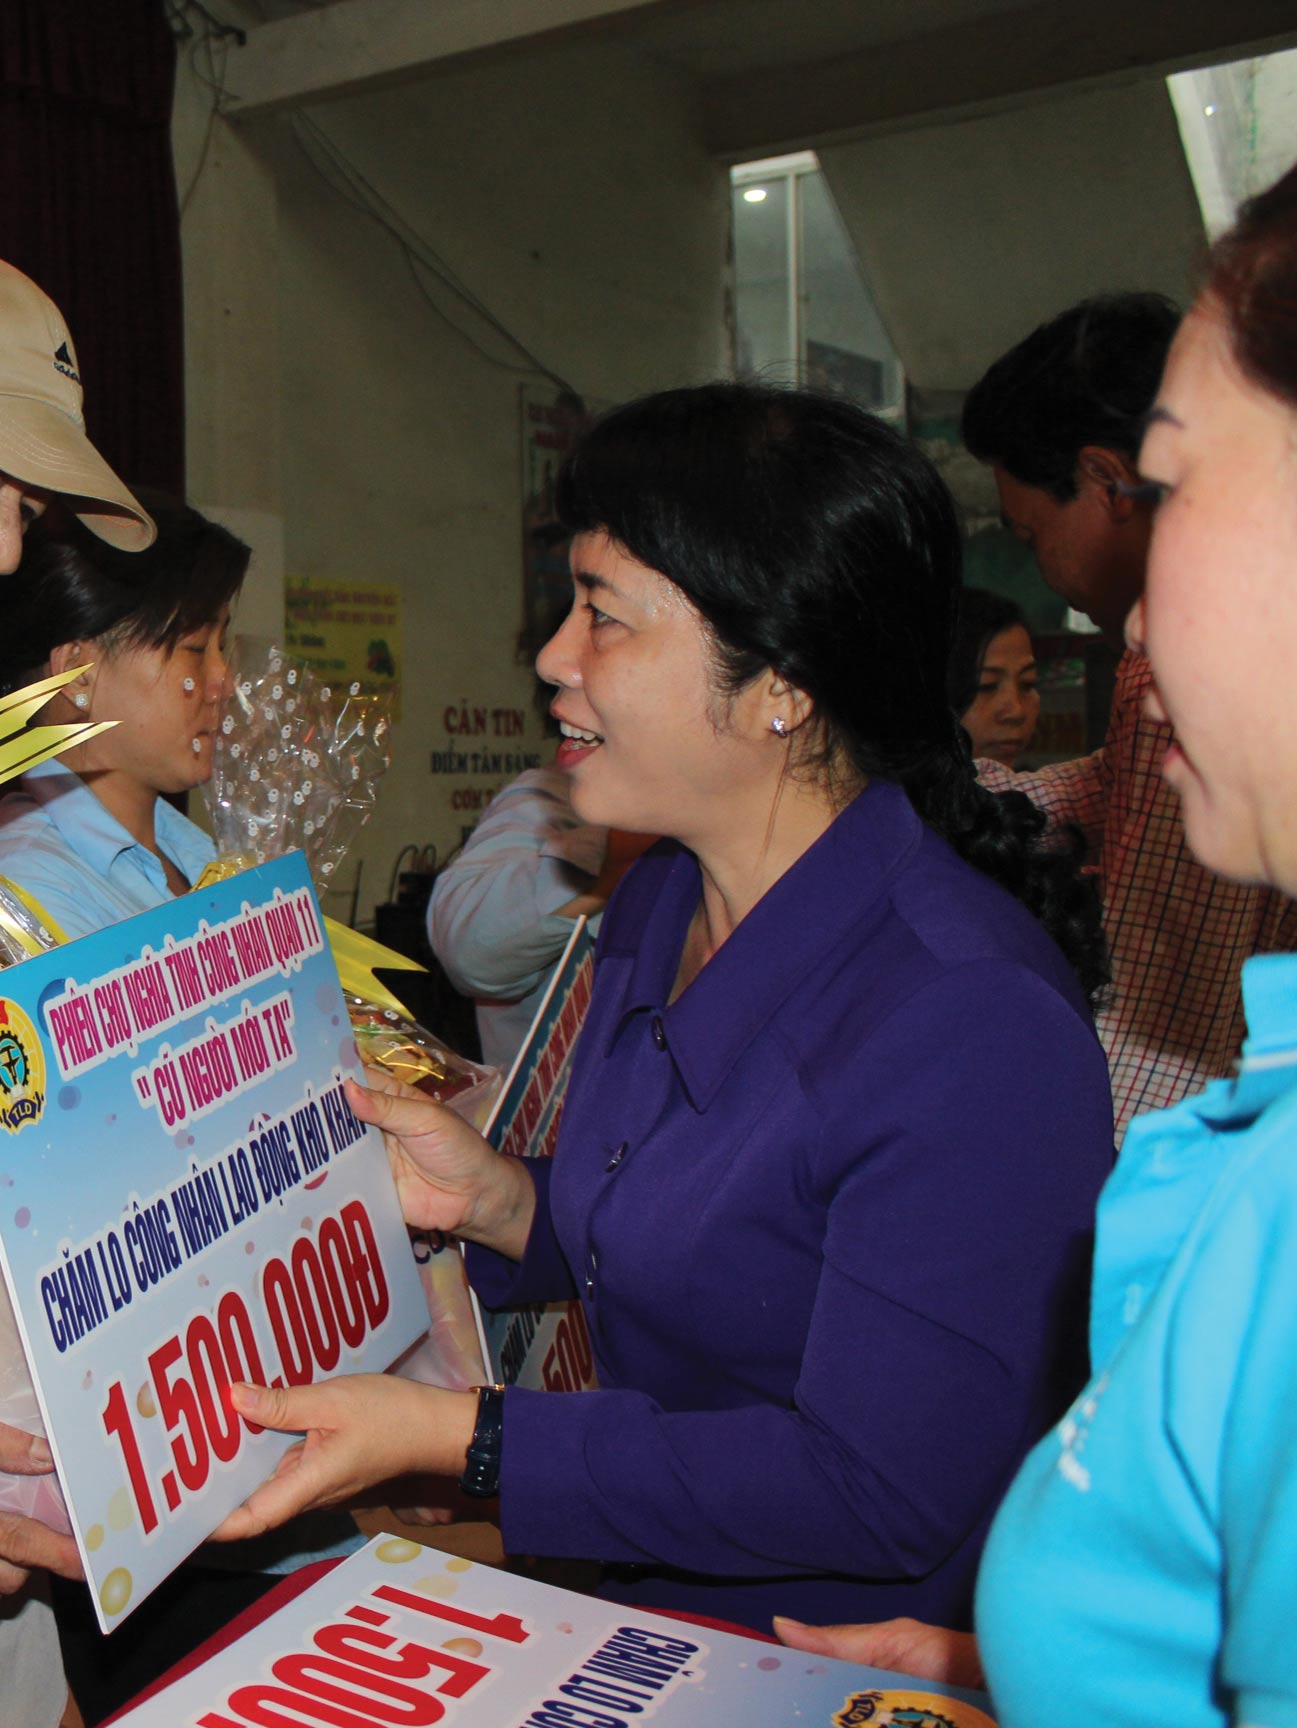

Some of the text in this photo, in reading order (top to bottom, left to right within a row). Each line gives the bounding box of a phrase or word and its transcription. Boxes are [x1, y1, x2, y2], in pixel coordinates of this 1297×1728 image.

[492, 708, 525, 738] TIN
[49, 894, 319, 1071] PHIÊN CHỢ NGHĨA TÌNH CÔNG NHÂN QUẬN 11
[179, 1025, 239, 1092] NGƯỜI
[230, 1007, 271, 1082] MỚI
[41, 1247, 109, 1353] CHĂM
[97, 1231, 132, 1312] LO
[124, 1201, 182, 1293] CÔNG
[171, 1163, 229, 1259] NHÂN
[218, 1147, 259, 1226] LAO
[249, 1121, 301, 1206] ĐỘNG
[290, 1088, 329, 1175] KHÓ
[558, 1673, 655, 1714] LO
[581, 1627, 700, 1691] CHĂM
